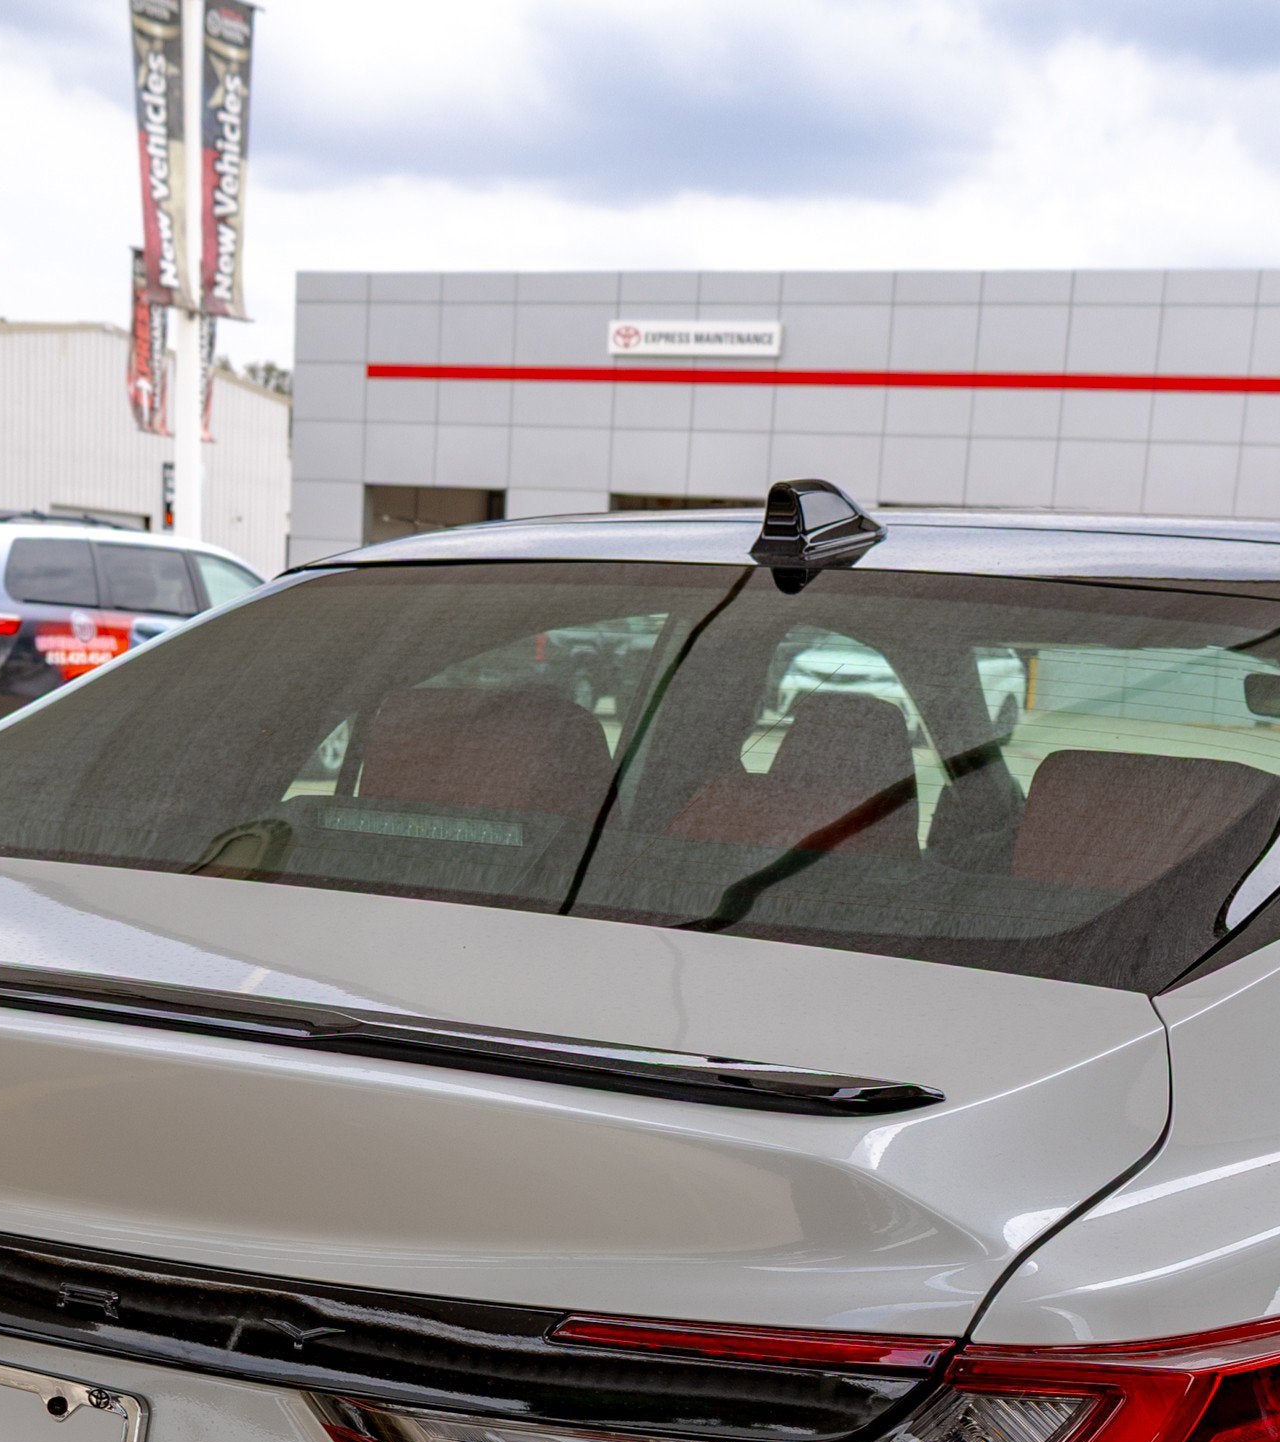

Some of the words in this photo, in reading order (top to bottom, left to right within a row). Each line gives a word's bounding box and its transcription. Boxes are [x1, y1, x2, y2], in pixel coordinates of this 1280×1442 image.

[213, 73, 243, 218] Vehicles
[159, 212, 178, 289] New
[213, 224, 238, 300] New
[644, 332, 690, 345] EXPRESS
[693, 332, 774, 346] MAINTENANCE
